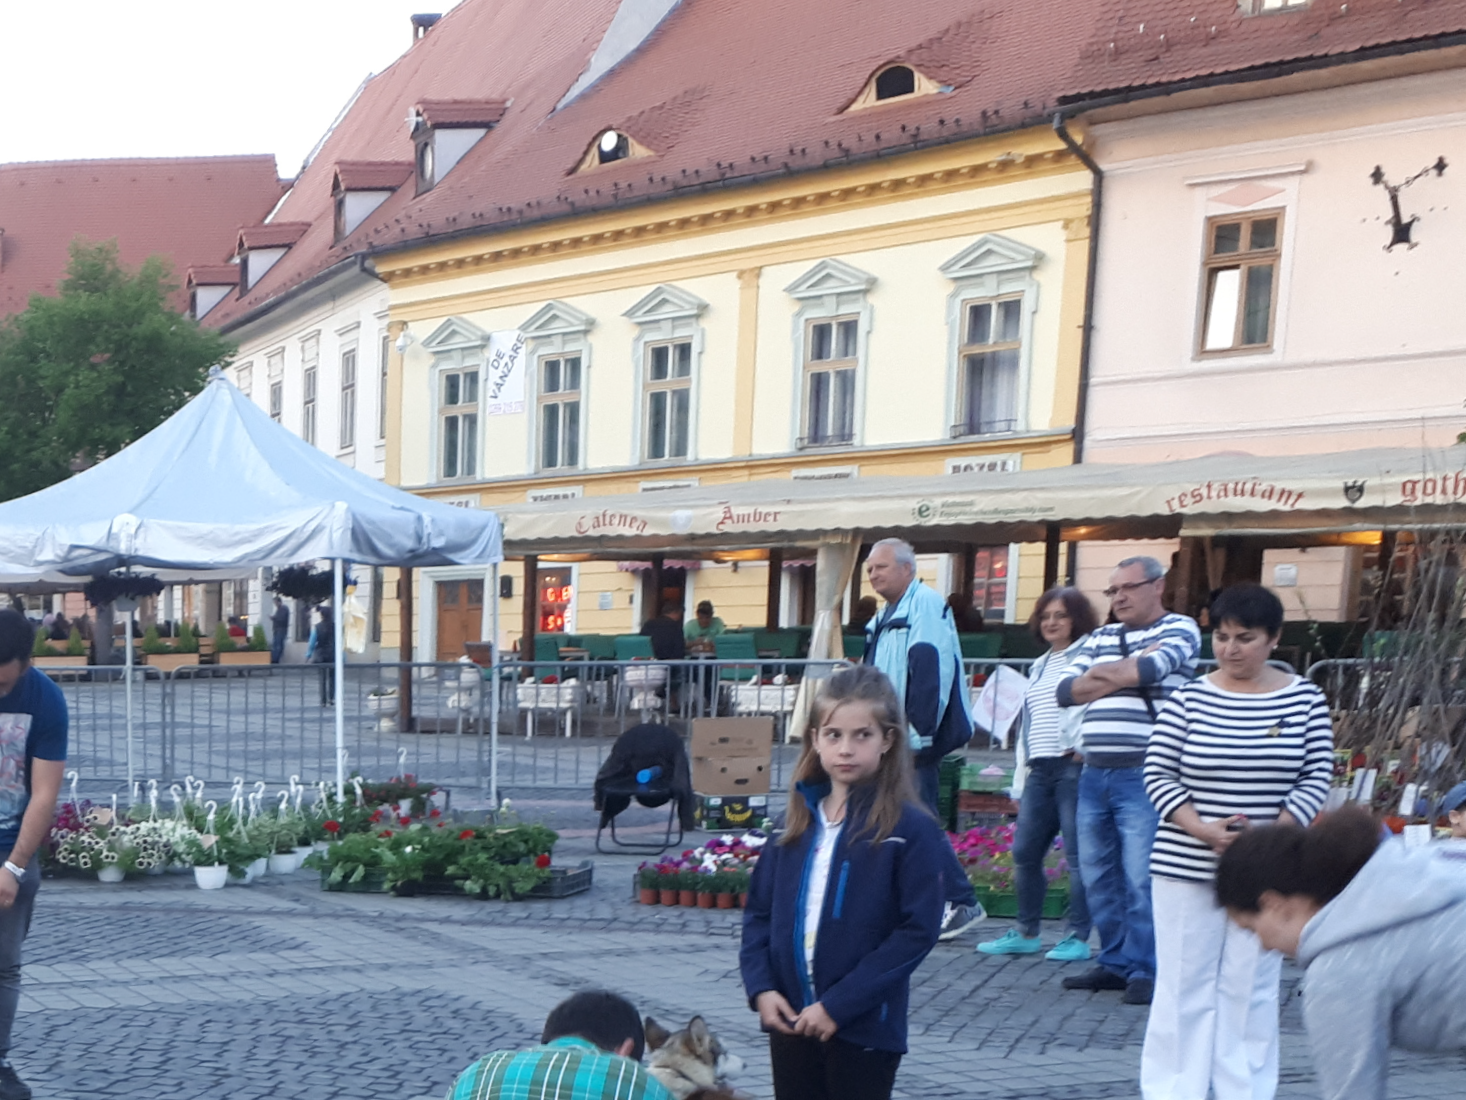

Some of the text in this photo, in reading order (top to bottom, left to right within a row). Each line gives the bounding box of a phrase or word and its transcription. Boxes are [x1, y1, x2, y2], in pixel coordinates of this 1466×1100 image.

[490, 348, 506, 370] DE
[1165, 476, 1305, 513] restaurant
[575, 501, 782, 535] Cafenea Amber
